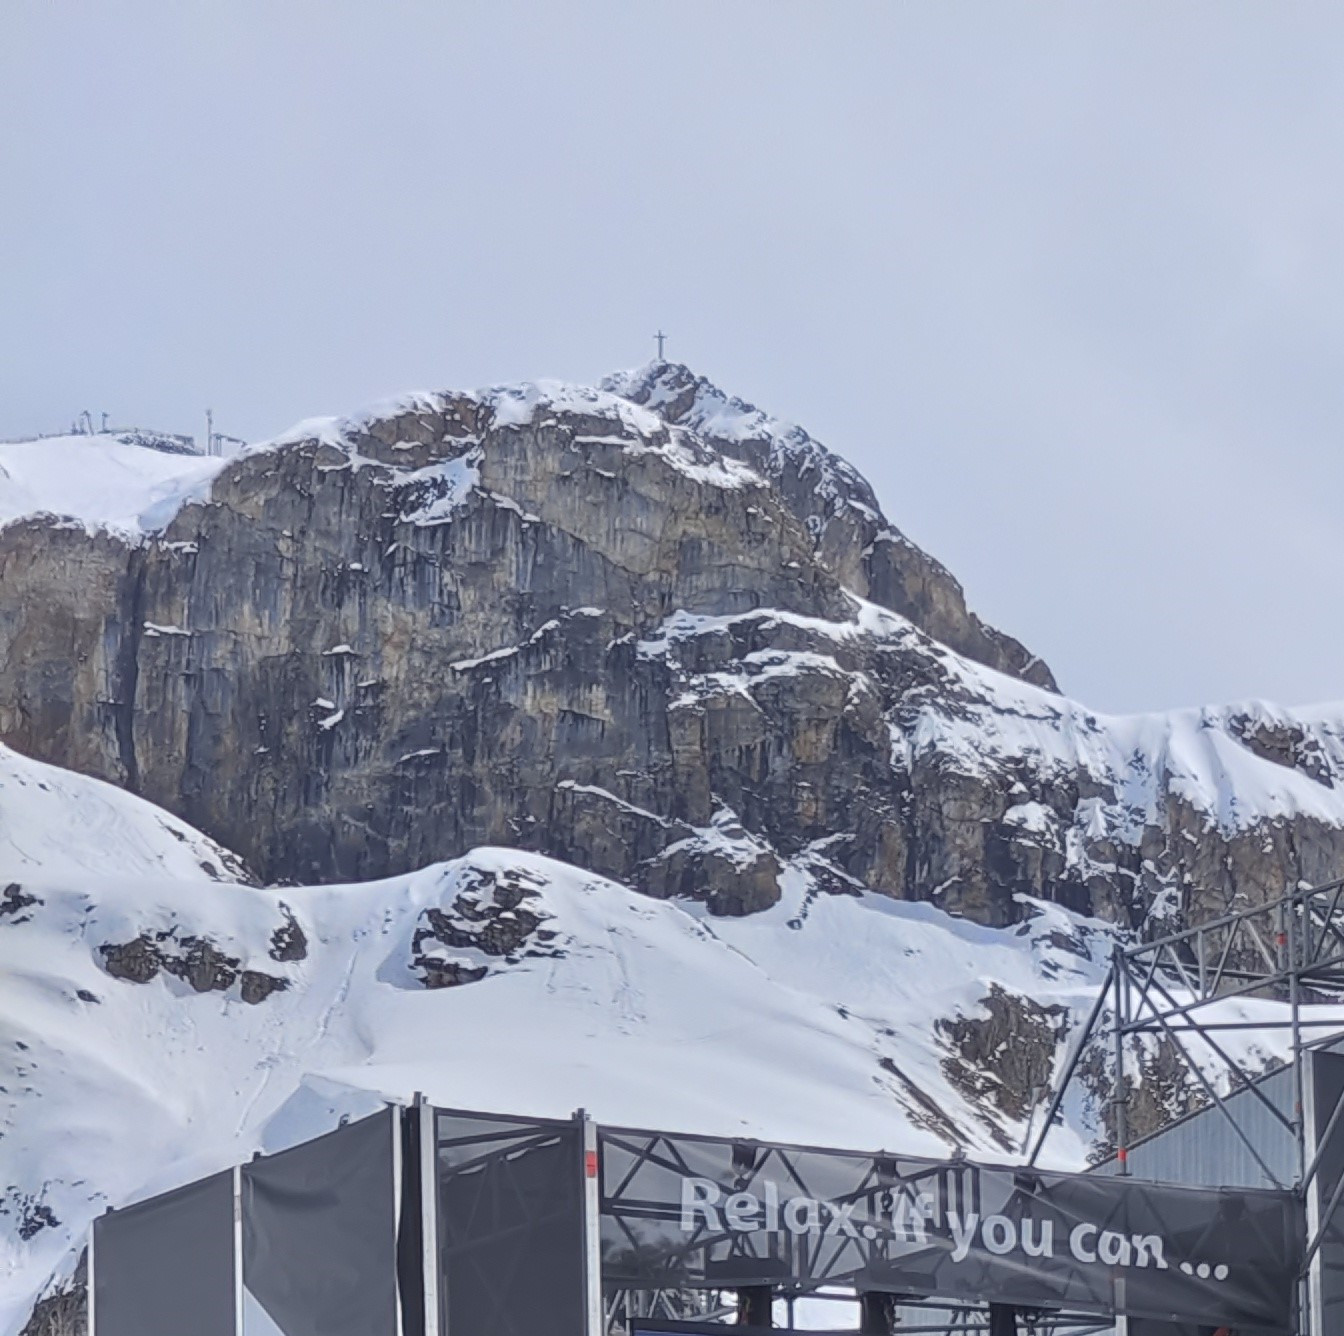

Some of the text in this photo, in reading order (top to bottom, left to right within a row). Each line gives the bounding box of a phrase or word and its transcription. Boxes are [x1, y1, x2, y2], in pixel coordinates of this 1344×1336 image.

[680, 1177, 877, 1241] Relax.
[945, 1208, 1055, 1263] you
[1069, 1220, 1169, 1270] can
